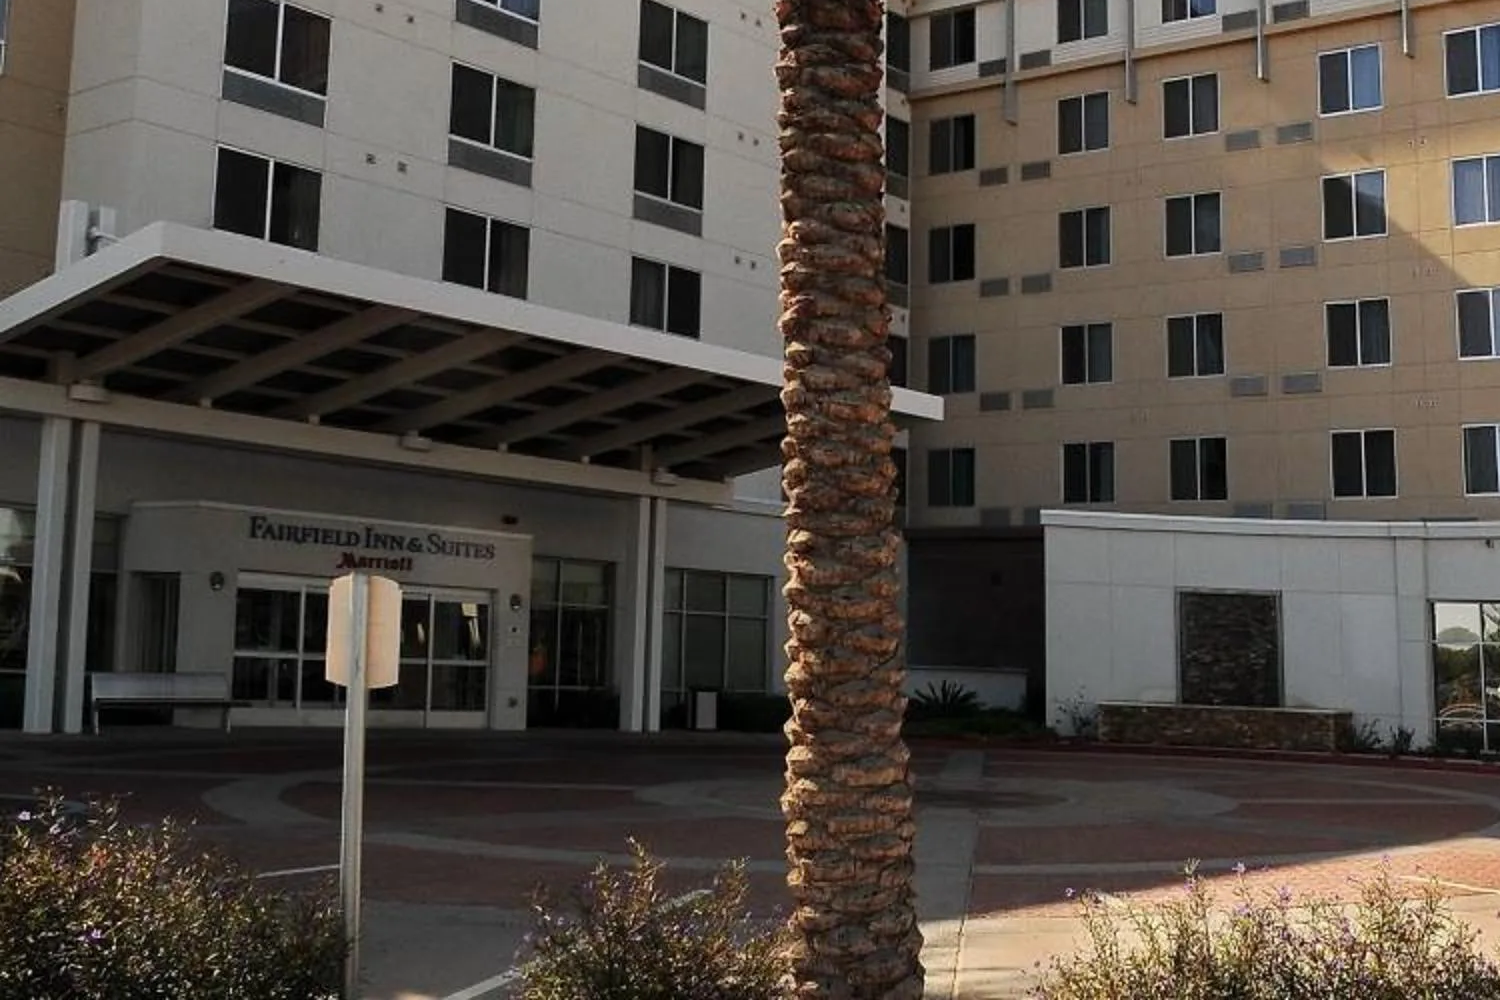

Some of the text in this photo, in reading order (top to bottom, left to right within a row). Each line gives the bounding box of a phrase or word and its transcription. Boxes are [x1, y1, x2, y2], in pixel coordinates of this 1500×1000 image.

[250, 515, 496, 560] FAIRFIELD INN & SUITES
[335, 551, 413, 571] Marriott
